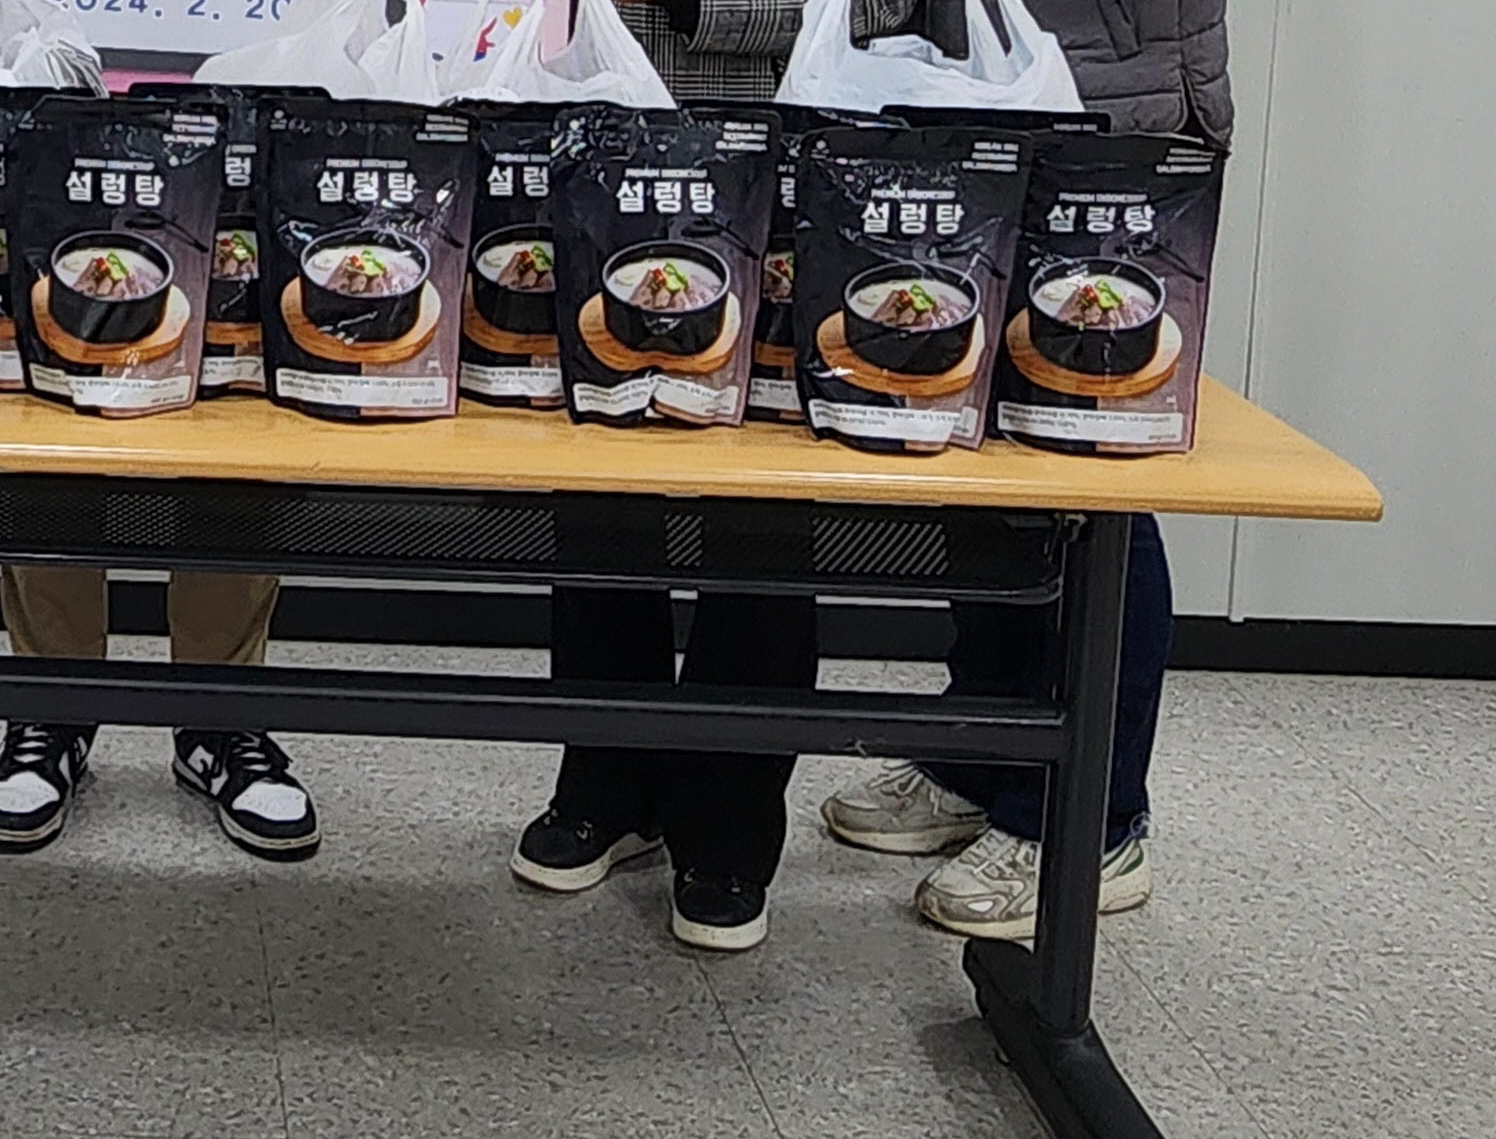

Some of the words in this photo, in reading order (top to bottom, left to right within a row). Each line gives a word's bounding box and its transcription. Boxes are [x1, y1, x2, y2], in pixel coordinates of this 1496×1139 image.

[66, 170, 164, 206] 설렁탕
[316, 171, 417, 203] 설렁탕
[616, 180, 716, 214] 설렁탕
[860, 201, 965, 235] 설렁탕
[1047, 204, 1156, 234] 설렁탕
